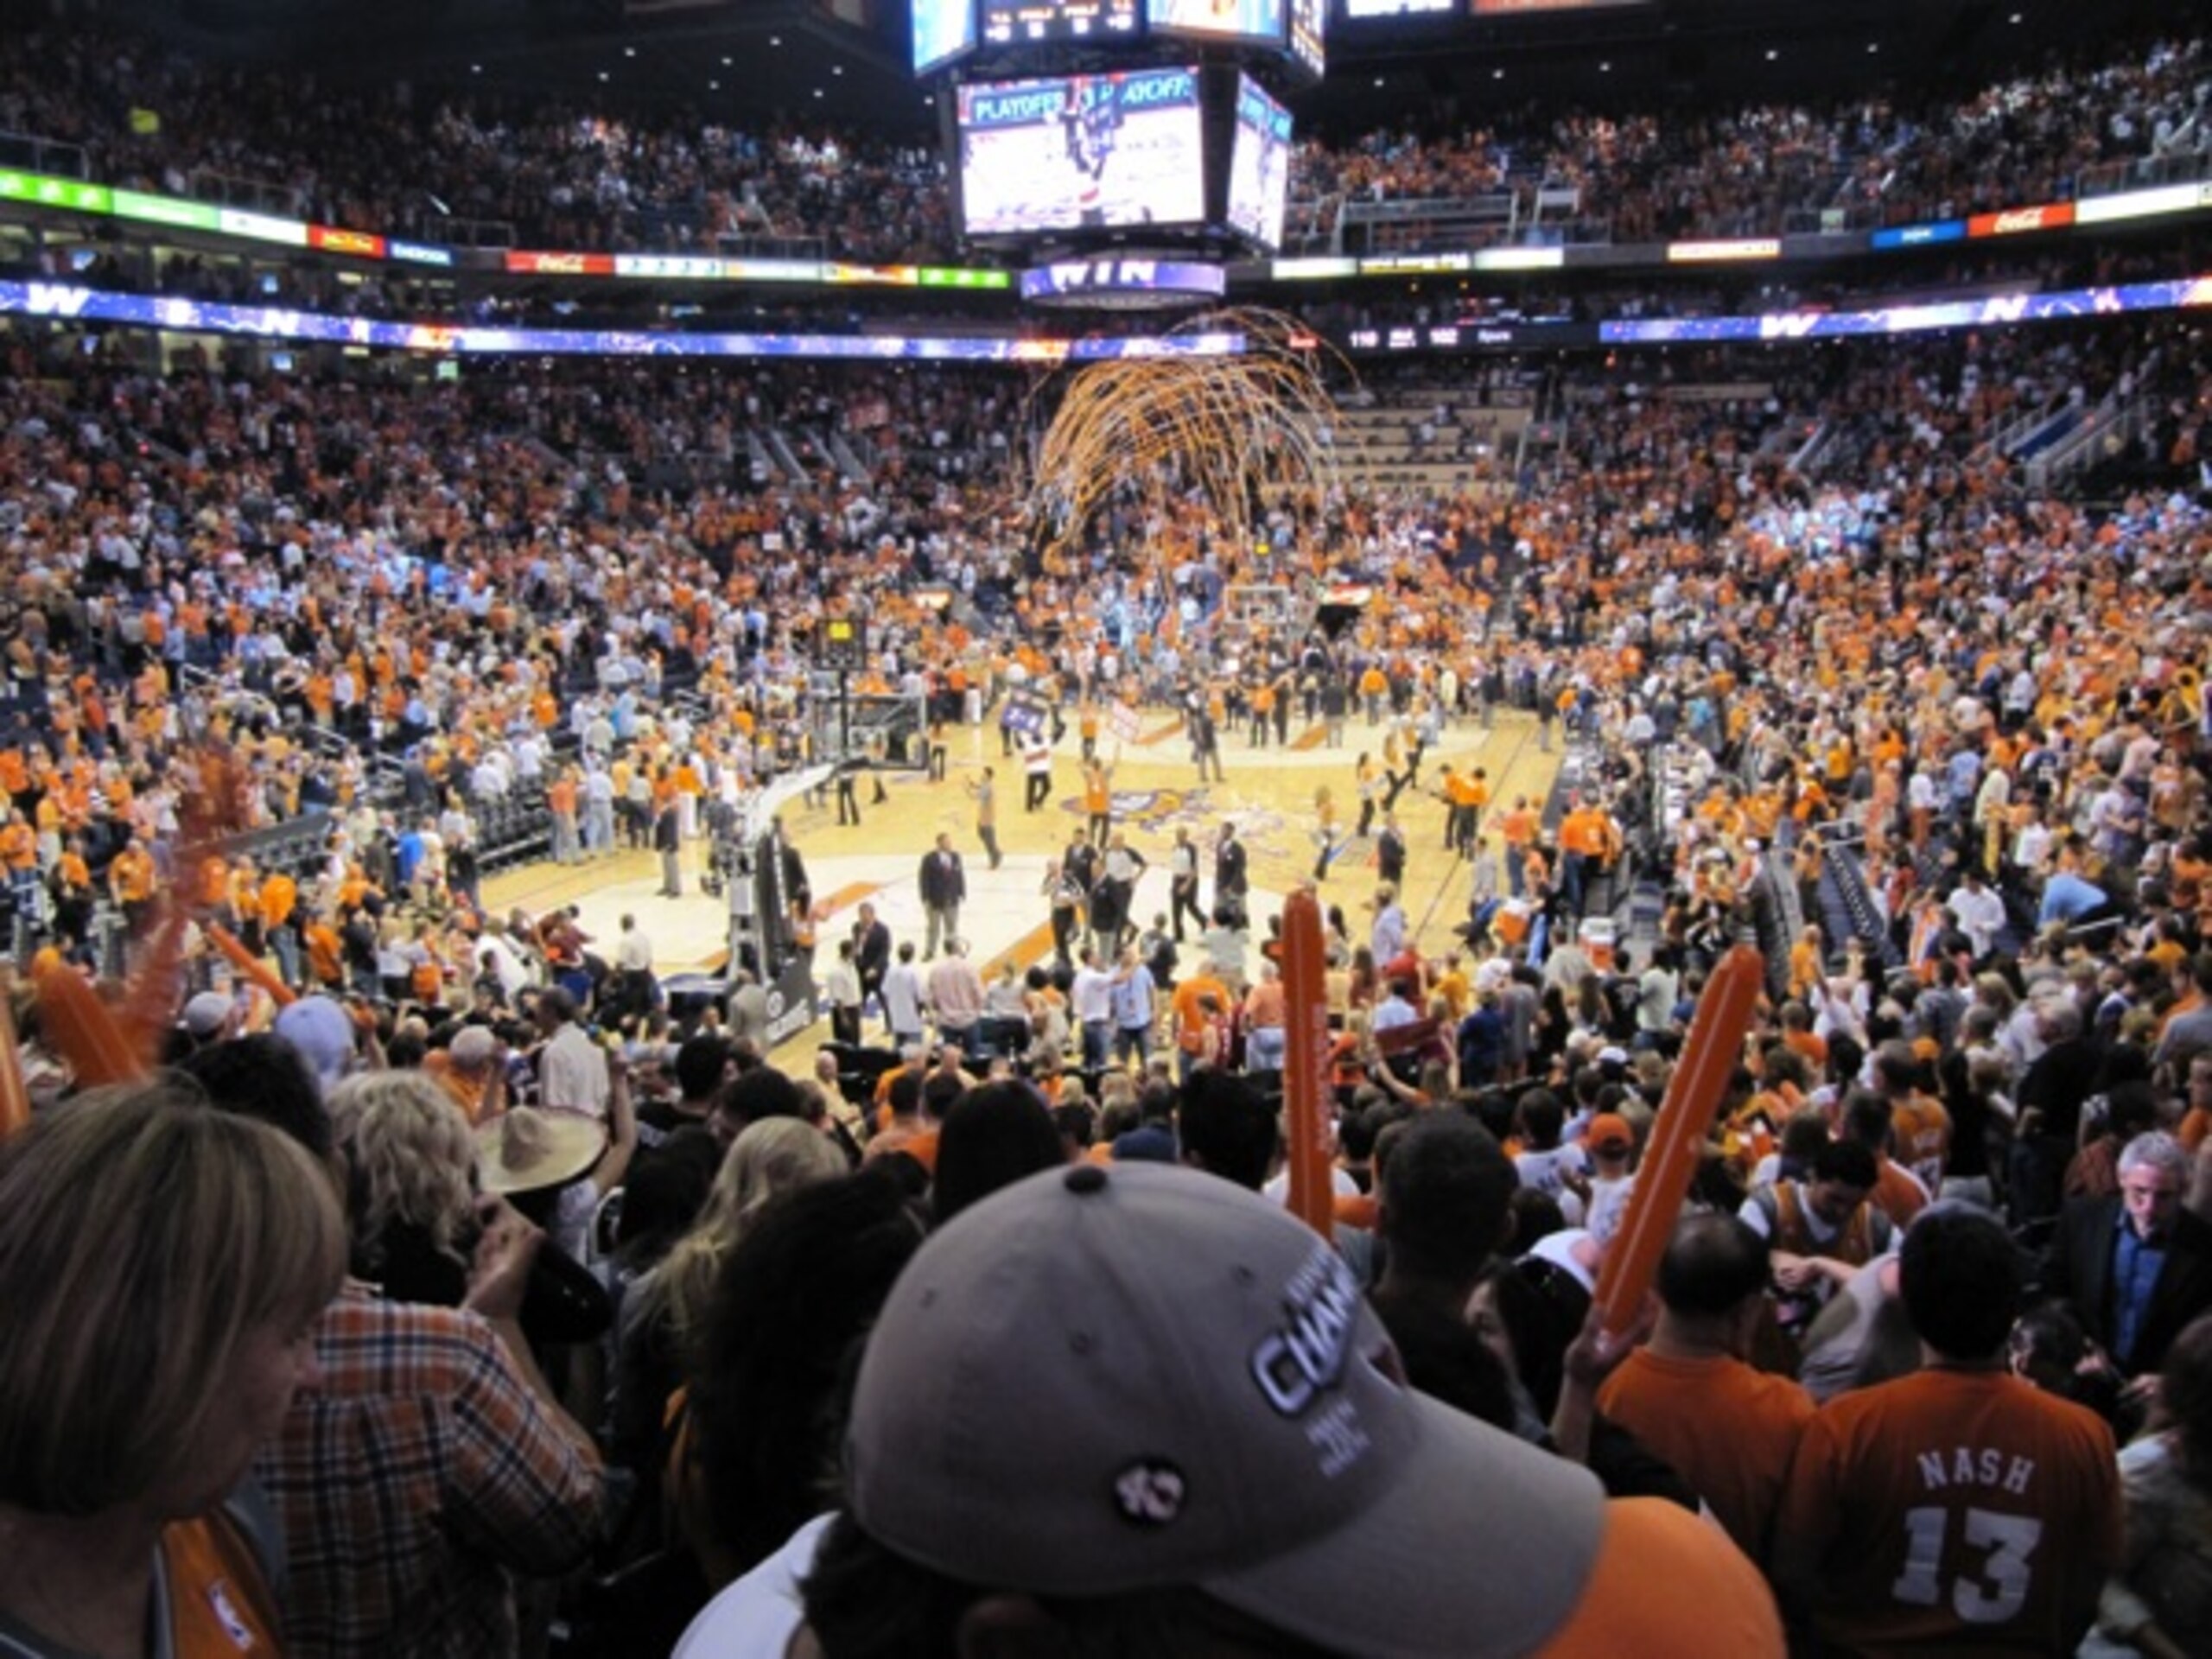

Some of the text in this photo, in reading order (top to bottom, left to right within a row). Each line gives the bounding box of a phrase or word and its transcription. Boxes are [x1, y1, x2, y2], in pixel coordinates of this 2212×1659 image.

[1049, 260, 1158, 292] WIN
[1916, 1446, 2035, 1495] NASH
[1891, 1506, 2044, 1624] 13
